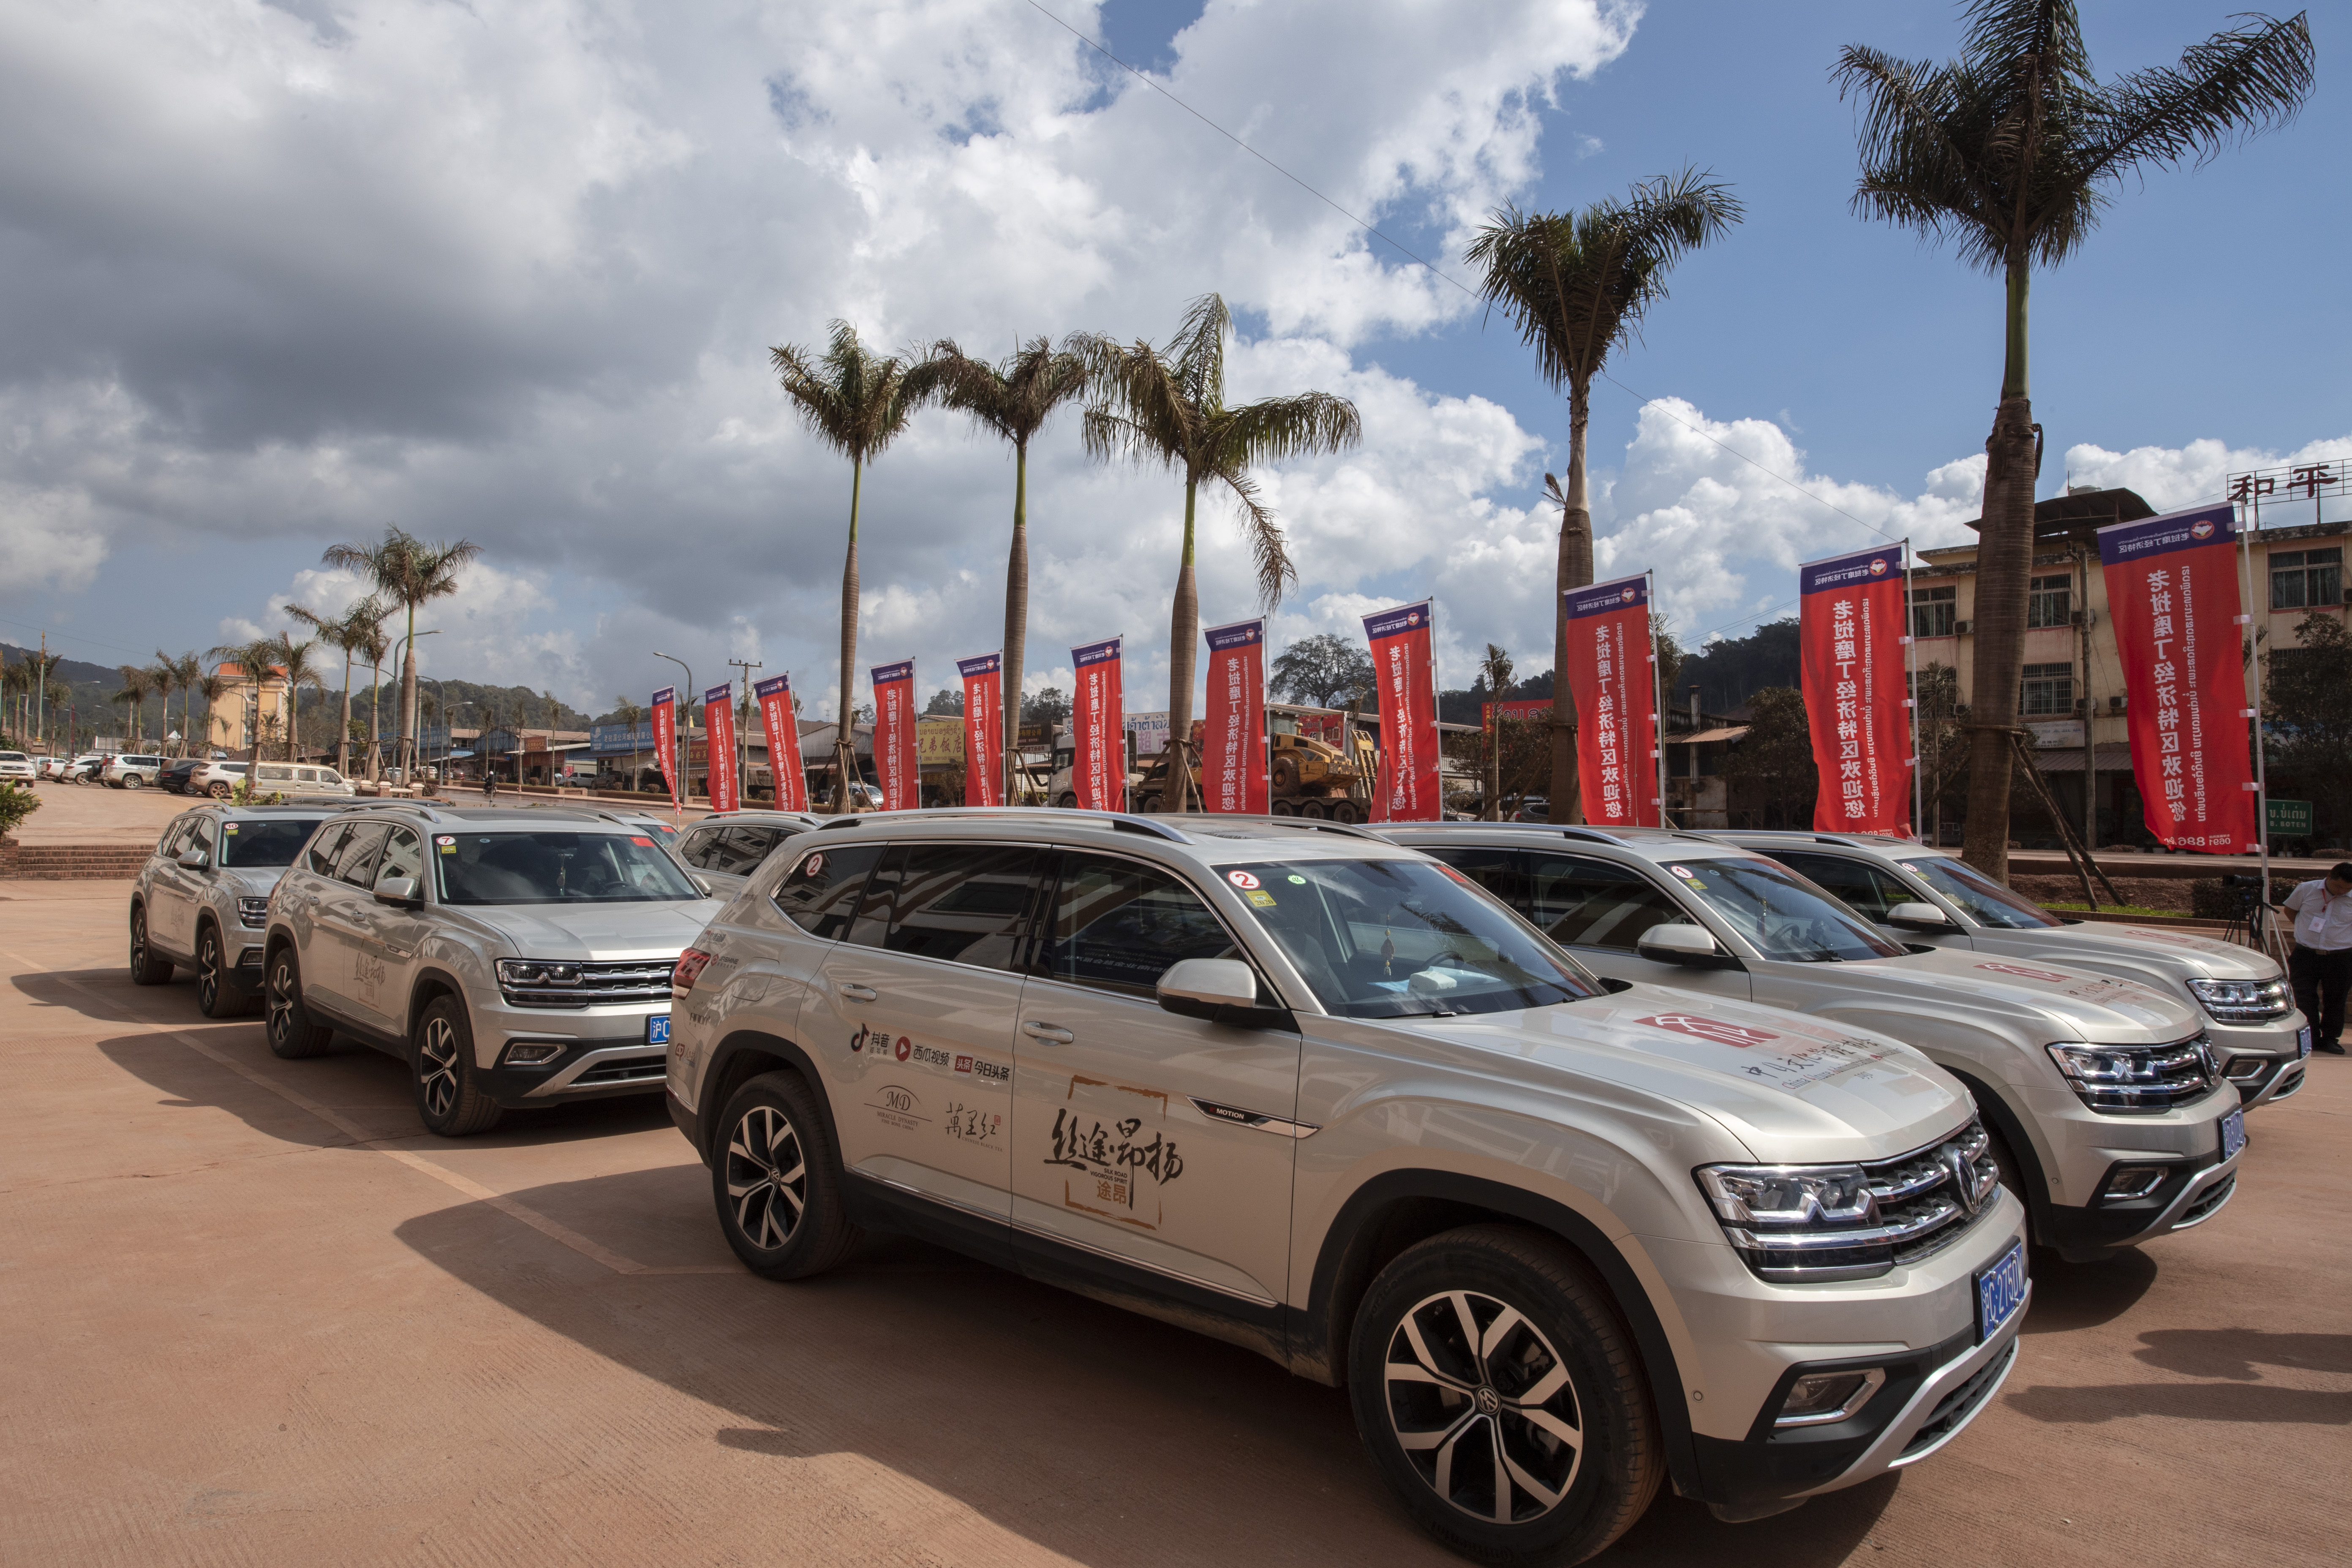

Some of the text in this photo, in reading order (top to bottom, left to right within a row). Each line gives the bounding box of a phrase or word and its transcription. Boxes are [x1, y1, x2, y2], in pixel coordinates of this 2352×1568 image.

[2227, 465, 2338, 505] 和平
[808, 856, 820, 874] 2
[1676, 868, 1689, 877] 1
[1235, 874, 1255, 886] 2
[871, 1031, 890, 1048] 抖音
[913, 1045, 950, 1067] 西瓜视频
[956, 1058, 971, 1071] 头条
[974, 1060, 1010, 1081] 今日头条
[1854, 1071, 1874, 1080] 1991
[1782, 1077, 1811, 1090] China
[886, 1091, 911, 1111] MD
[877, 1111, 919, 1127] MIRACLE DYNASTY
[961, 1136, 980, 1146] CHINESE
[980, 1142, 994, 1150] BLACK
[1090, 1171, 1127, 1185] VIGOROUS SPIRIT
[1114, 1170, 1127, 1179] ROAD
[1097, 1180, 1127, 1204] 途昂
